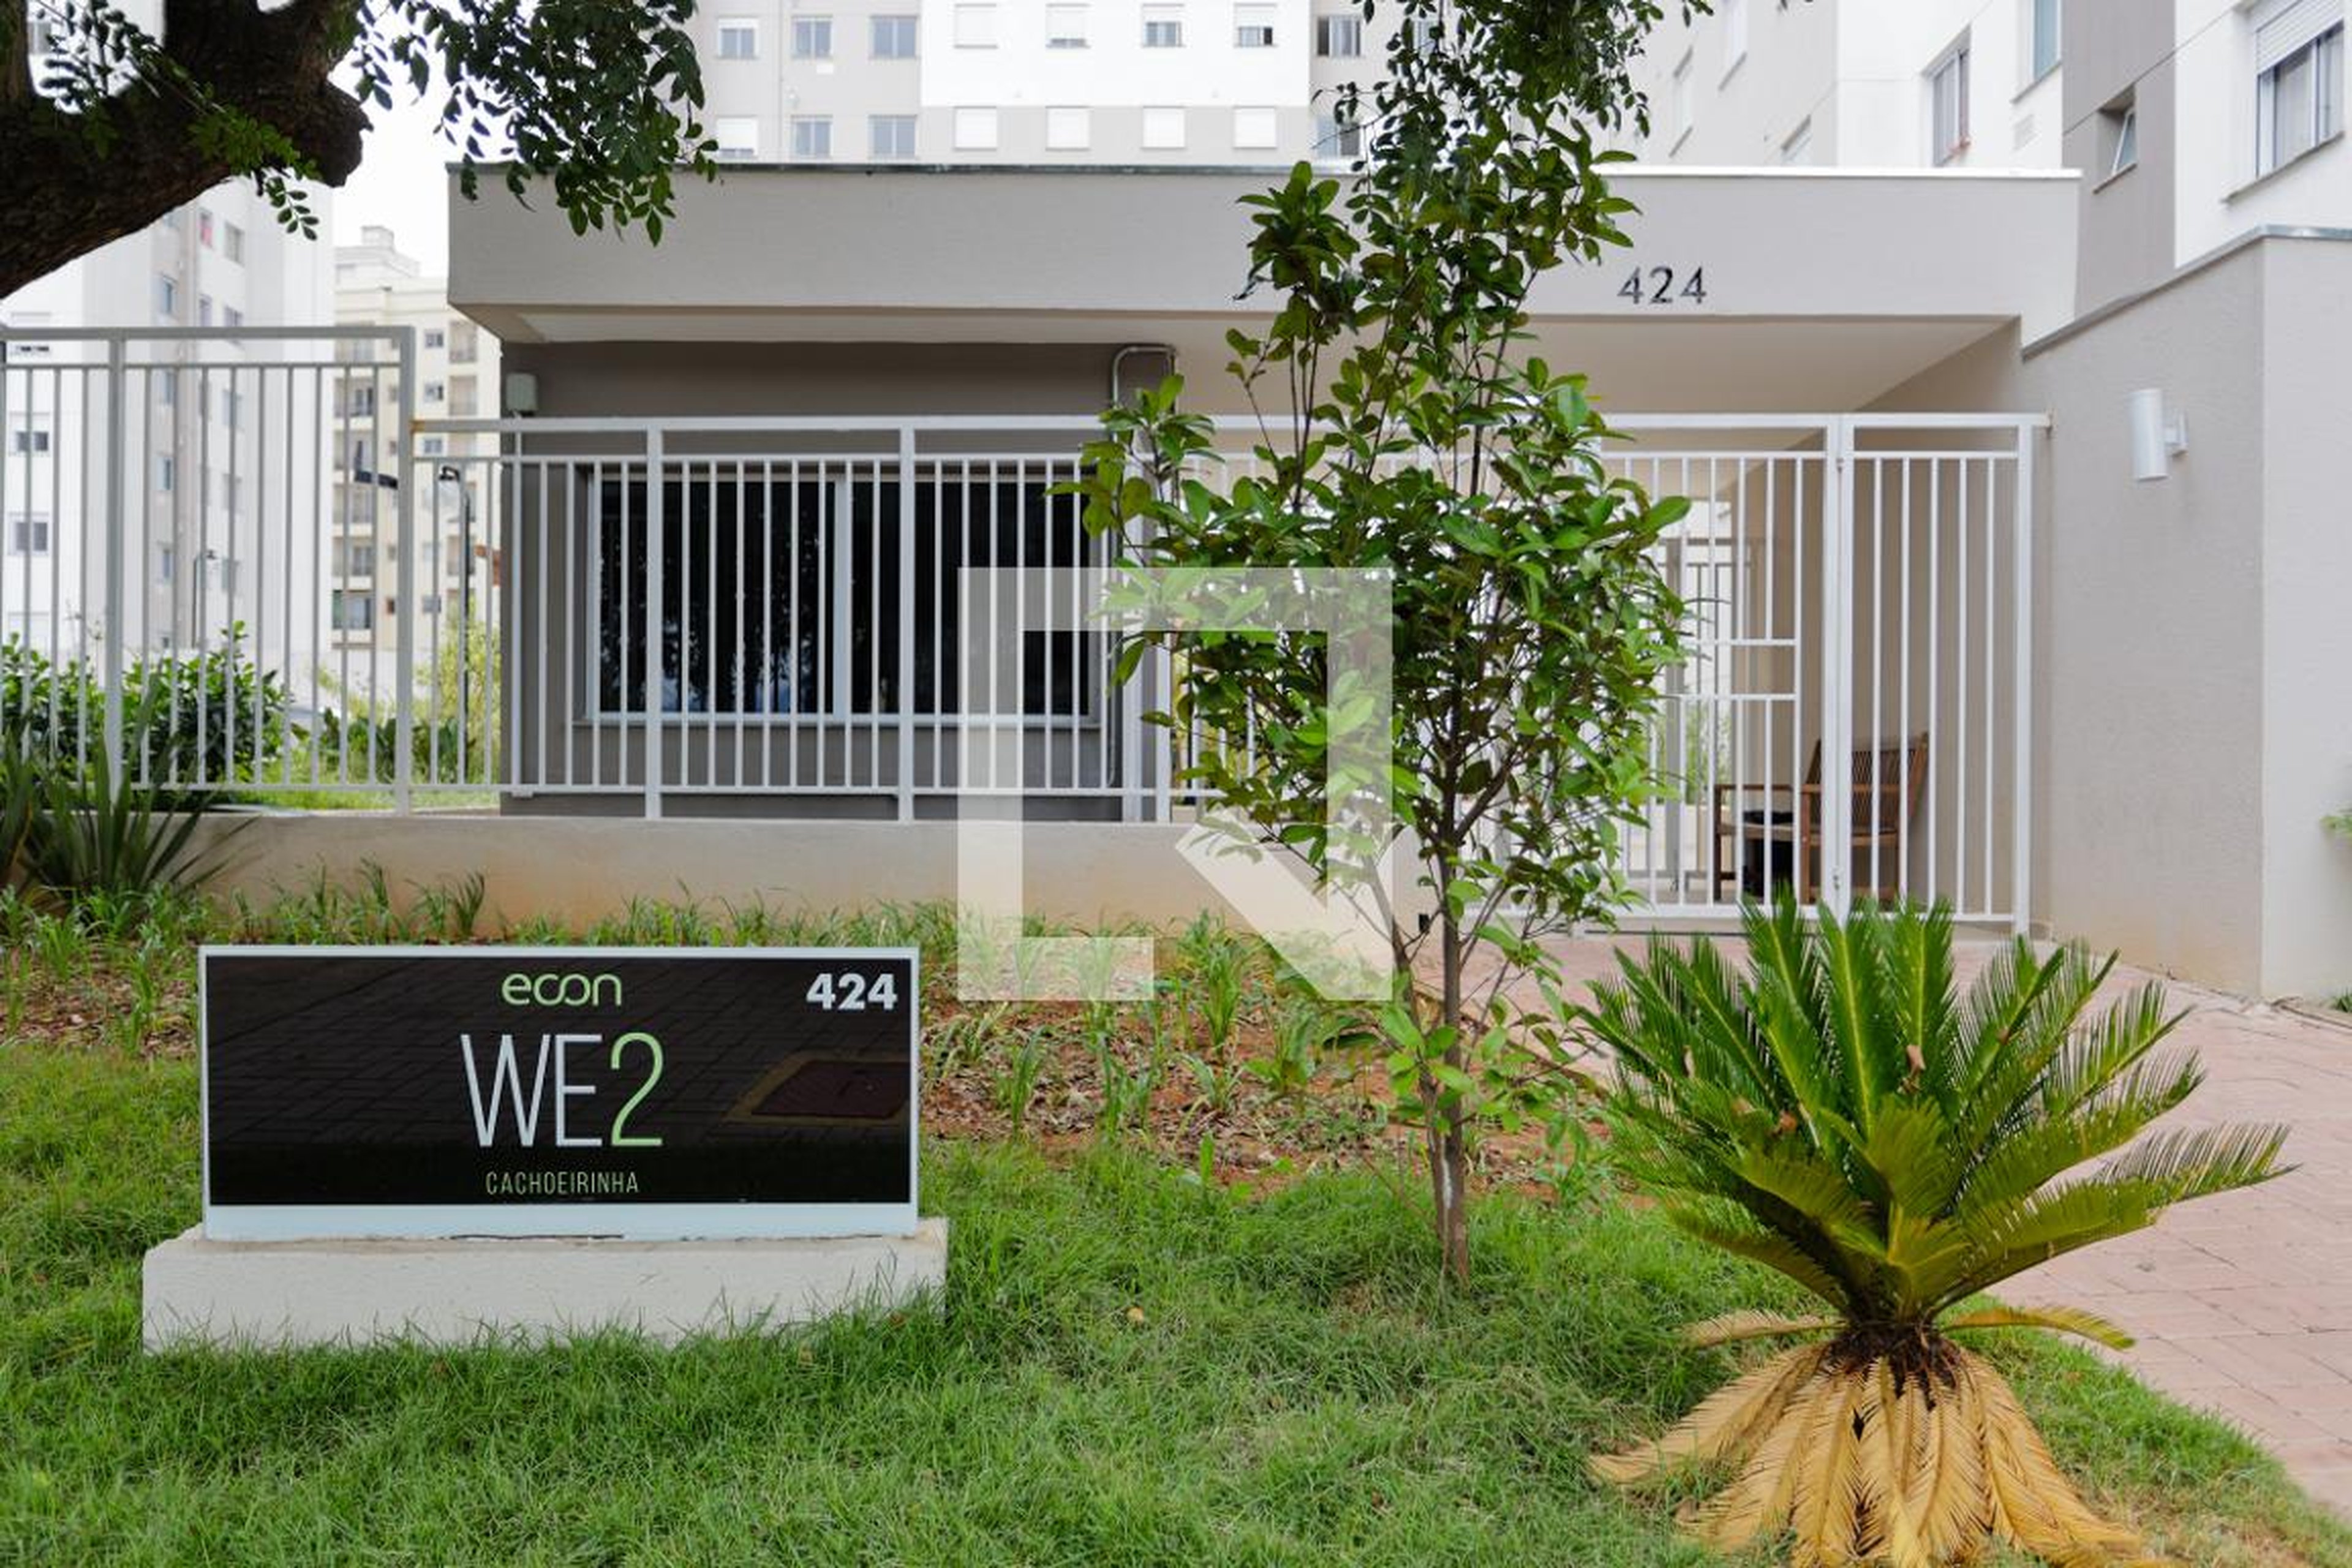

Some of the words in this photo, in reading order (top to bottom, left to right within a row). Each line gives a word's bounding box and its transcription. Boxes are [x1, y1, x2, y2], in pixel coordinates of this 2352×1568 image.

[1617, 266, 1706, 304] 424
[501, 972, 622, 1007] econ
[806, 973, 899, 1010] 424
[461, 1032, 664, 1148] WE2
[485, 1170, 639, 1196] CACHOEIRINHA
